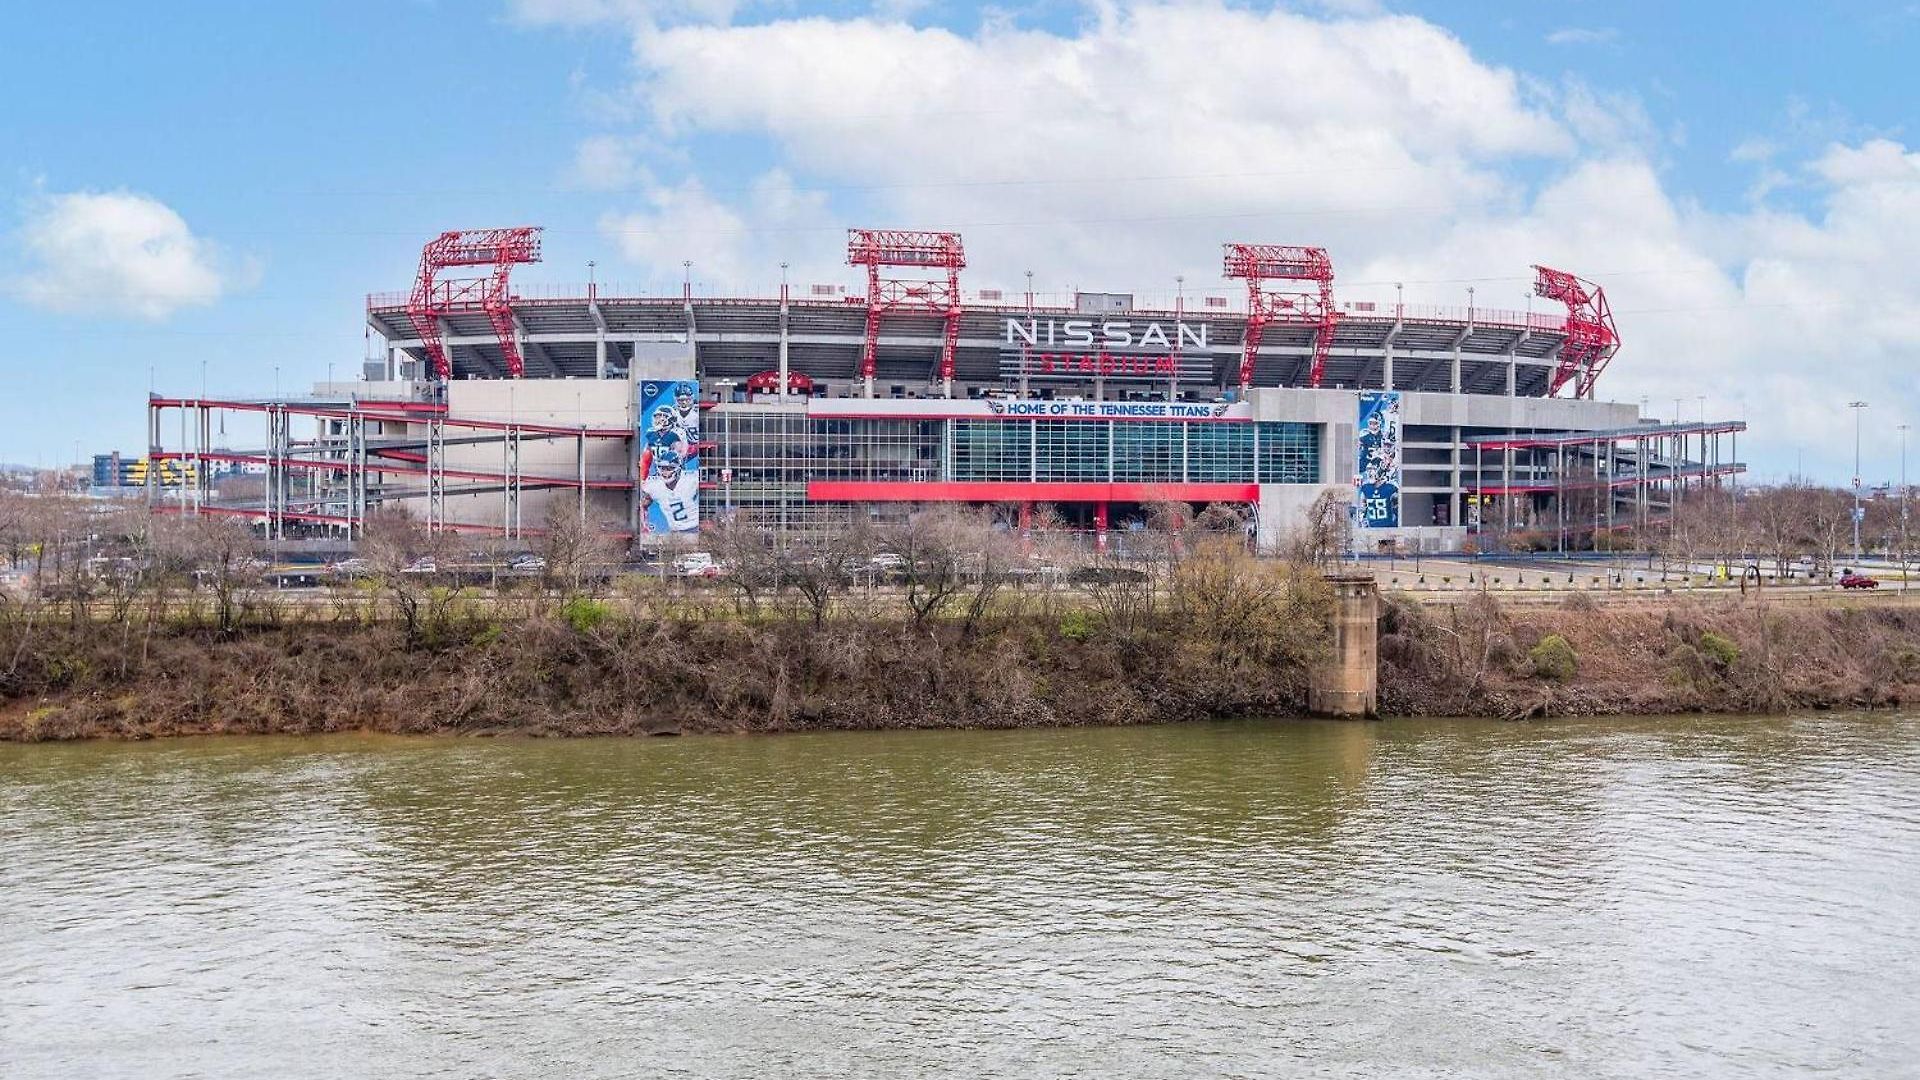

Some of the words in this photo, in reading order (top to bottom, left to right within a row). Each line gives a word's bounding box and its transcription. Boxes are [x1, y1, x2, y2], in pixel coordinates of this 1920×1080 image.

[1006, 318, 1207, 349] NISSAN
[1040, 353, 1175, 375] STADIUM
[1007, 403, 1046, 415] HOME
[1050, 403, 1068, 415] OF
[1072, 403, 1095, 415] THE
[1099, 404, 1166, 416] TENNESSEE
[1169, 406, 1210, 417] TITANS
[1366, 498, 1388, 520] 58
